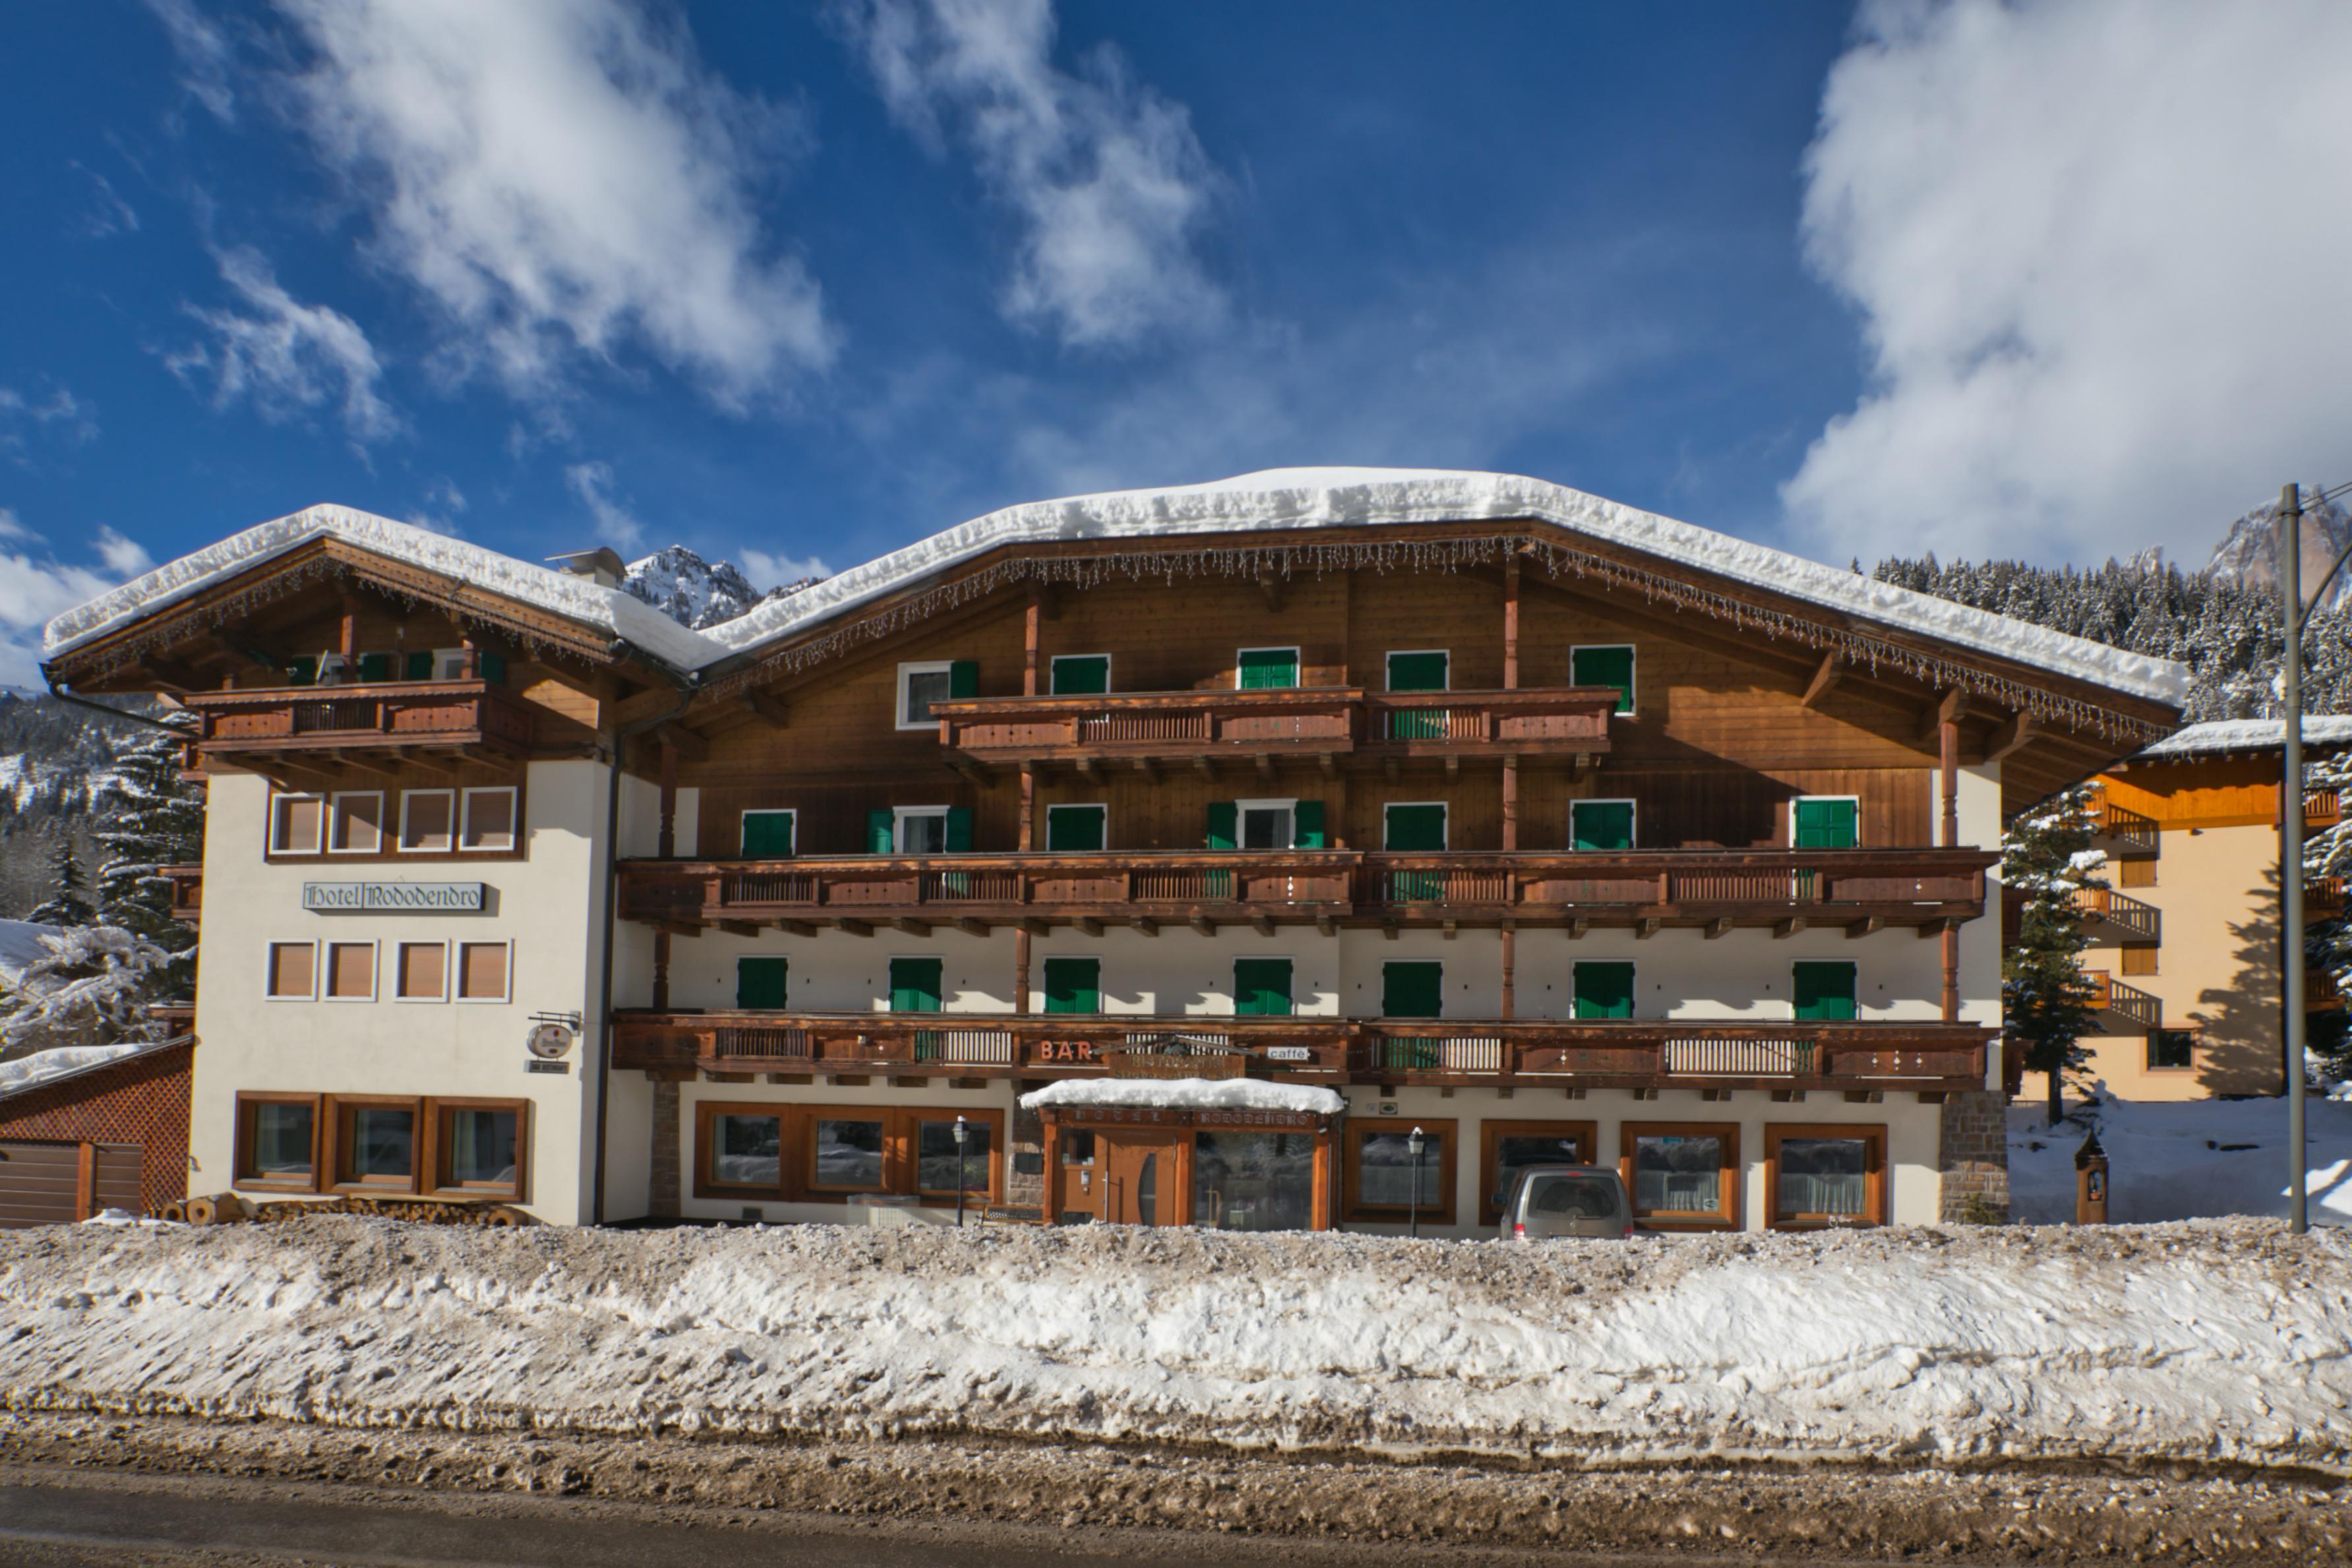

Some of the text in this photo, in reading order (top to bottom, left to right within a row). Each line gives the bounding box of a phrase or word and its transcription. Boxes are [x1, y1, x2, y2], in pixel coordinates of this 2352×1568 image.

[306, 886, 479, 906] Hotel Rododendro
[1040, 1040, 1092, 1060] BAR
[1271, 1048, 1305, 1058] caffè
